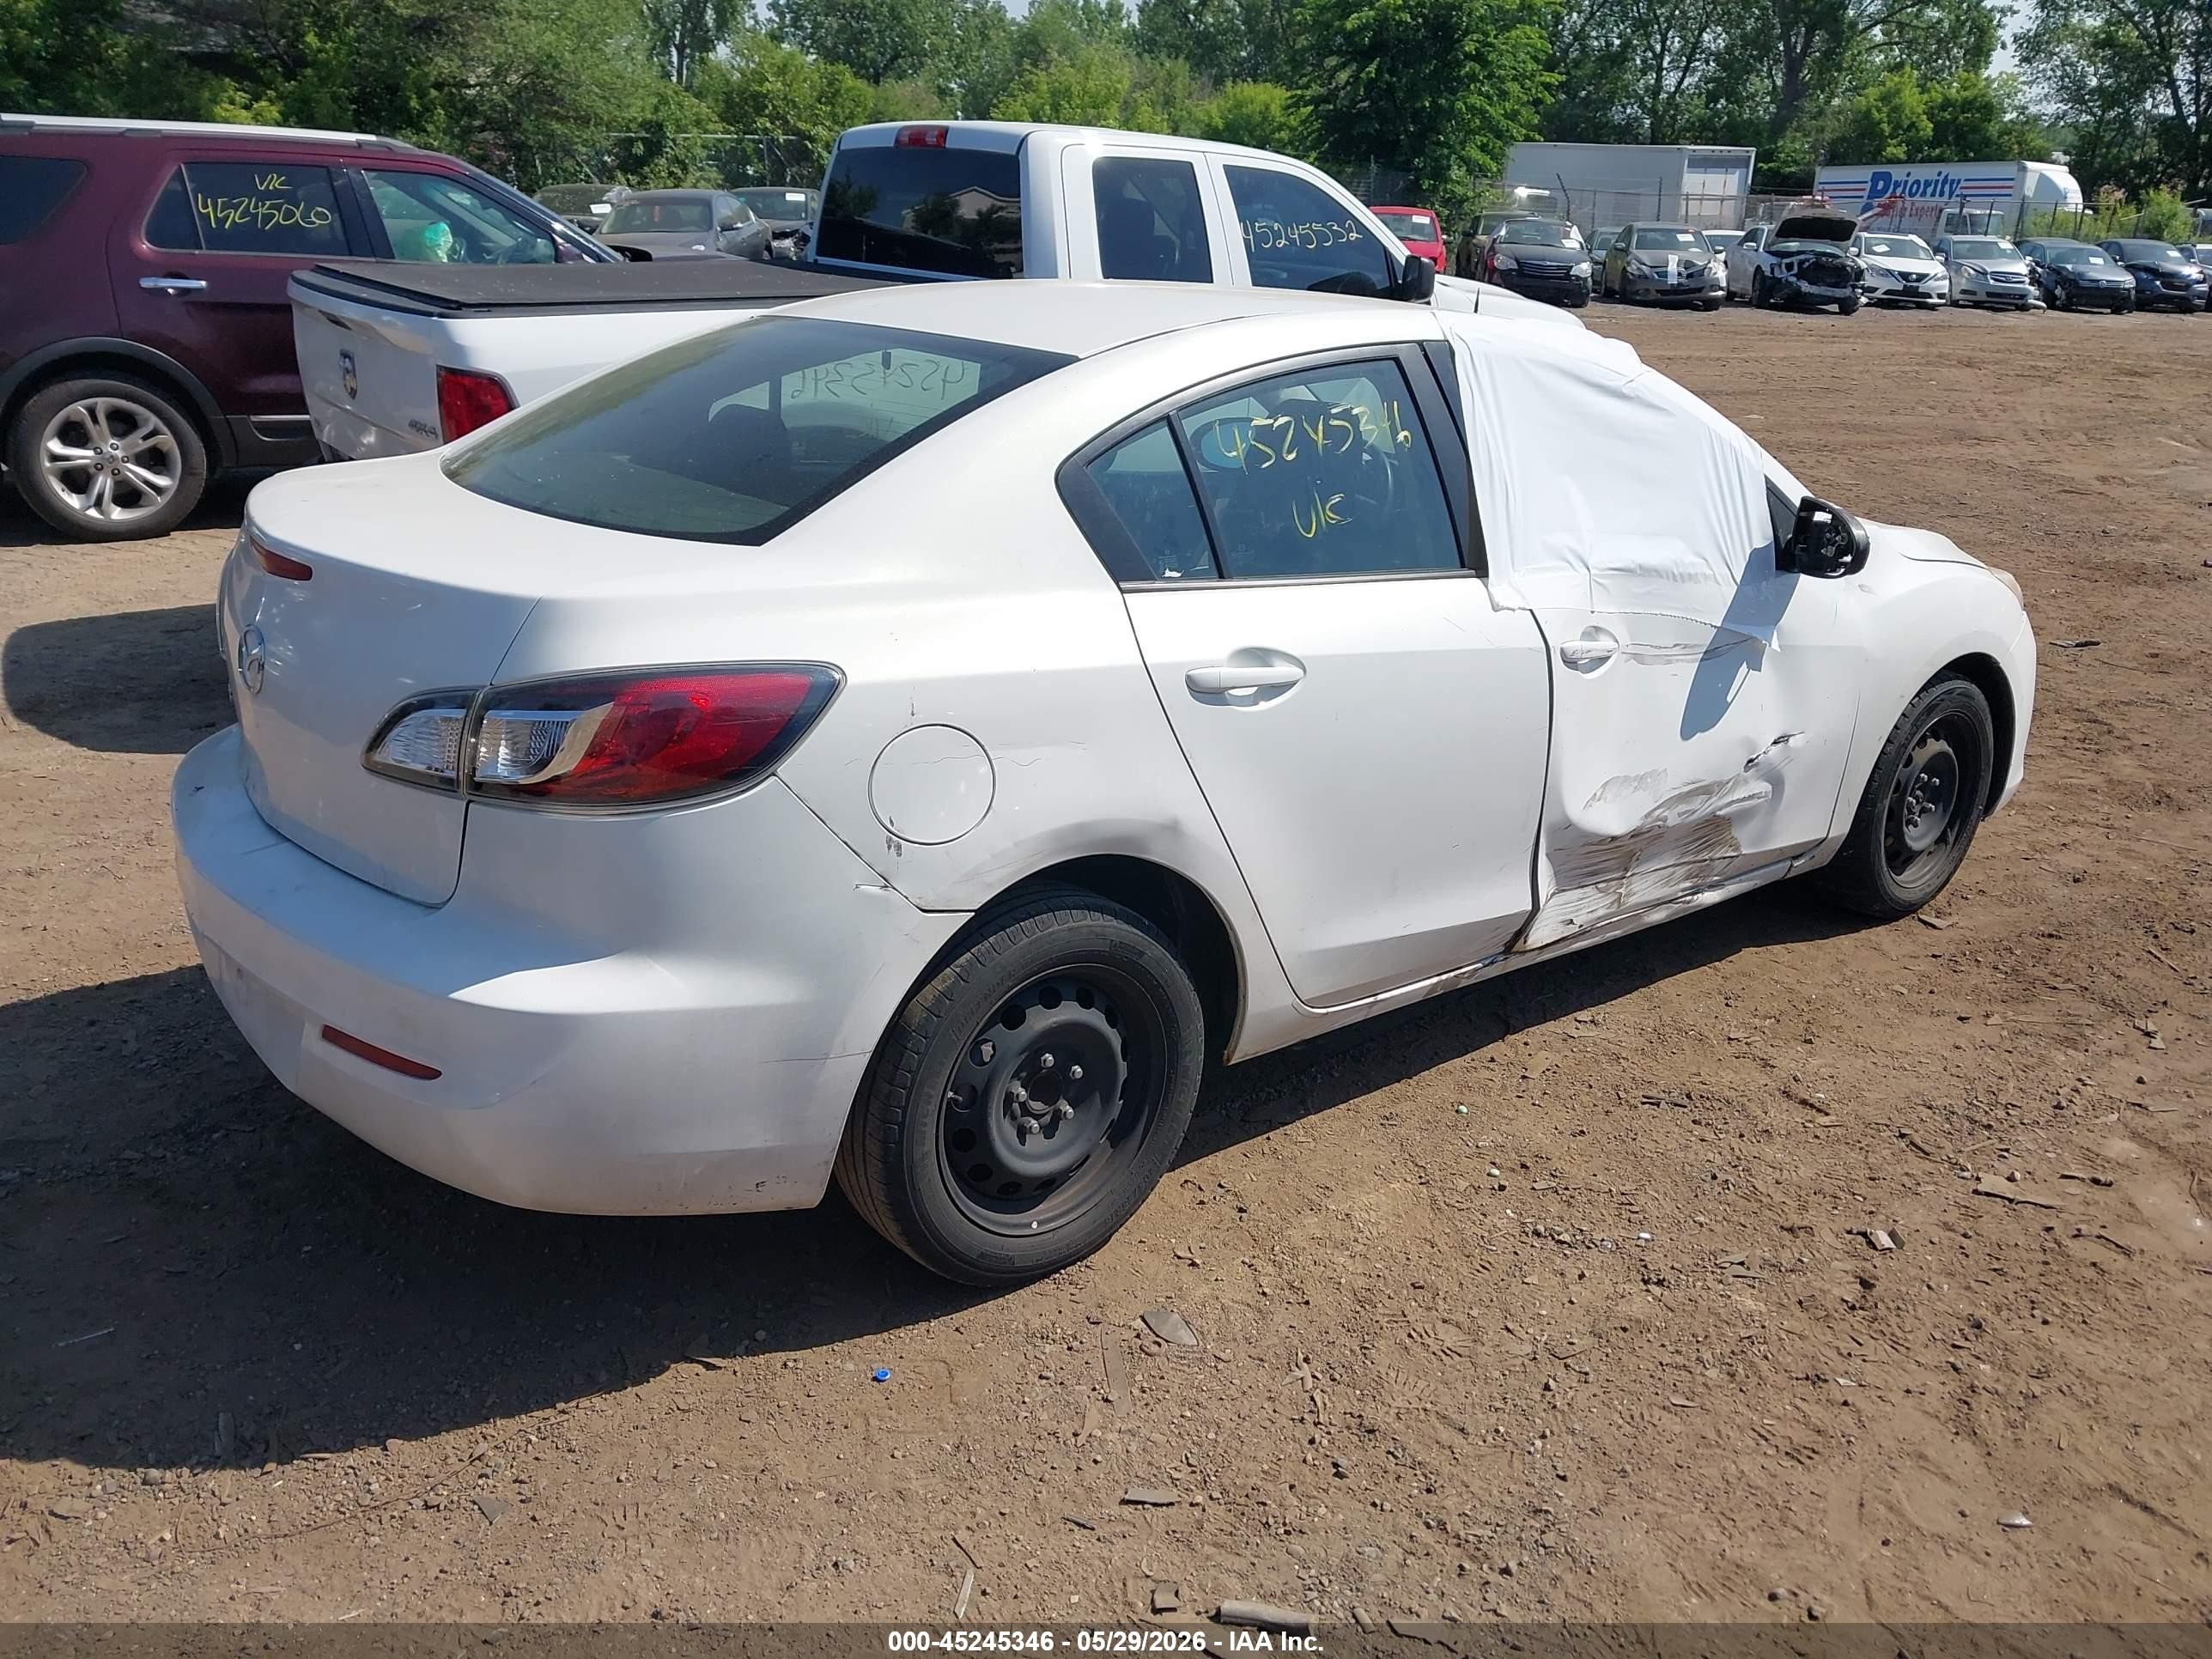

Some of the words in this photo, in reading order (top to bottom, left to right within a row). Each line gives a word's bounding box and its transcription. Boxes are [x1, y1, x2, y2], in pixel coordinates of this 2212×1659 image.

[198, 192, 332, 231] 45245060
[1861, 170, 1961, 216] Priority
[1239, 219, 1364, 253] 45245532
